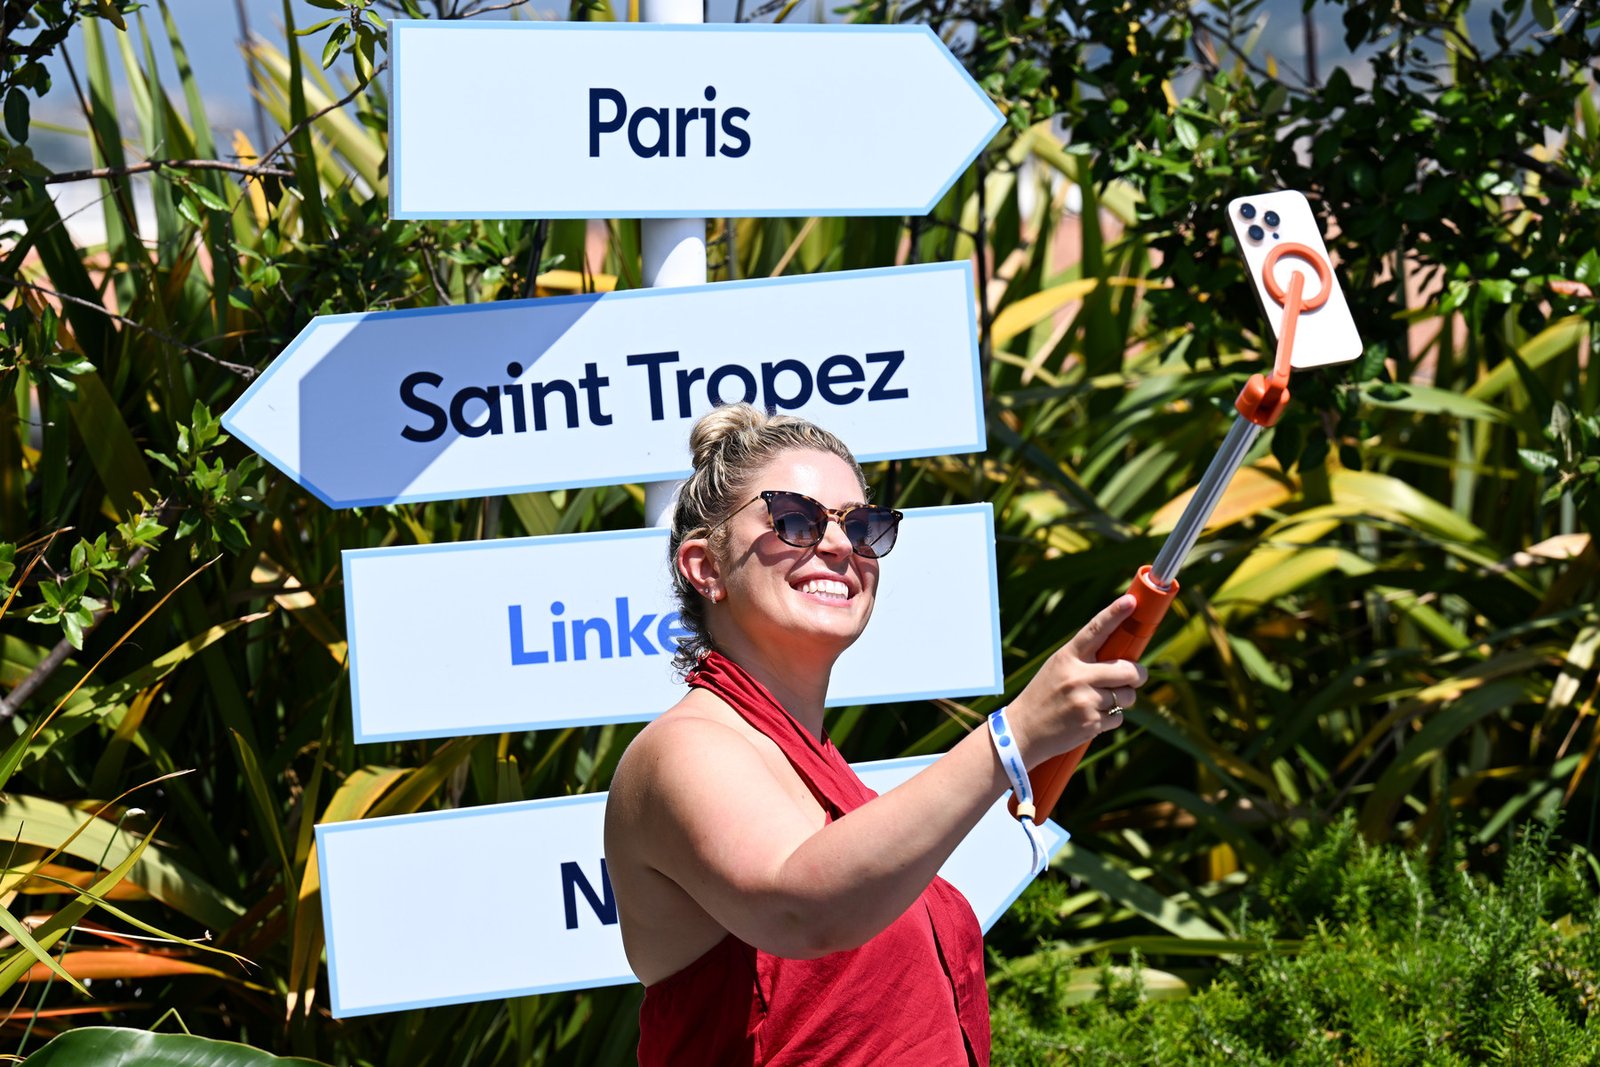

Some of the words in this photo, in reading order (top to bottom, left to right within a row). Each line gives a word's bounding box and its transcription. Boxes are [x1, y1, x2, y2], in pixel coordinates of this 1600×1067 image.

[589, 85, 751, 158] Paris
[399, 361, 613, 443] Saint
[626, 350, 909, 420] Tropez
[507, 596, 696, 666] Linke
